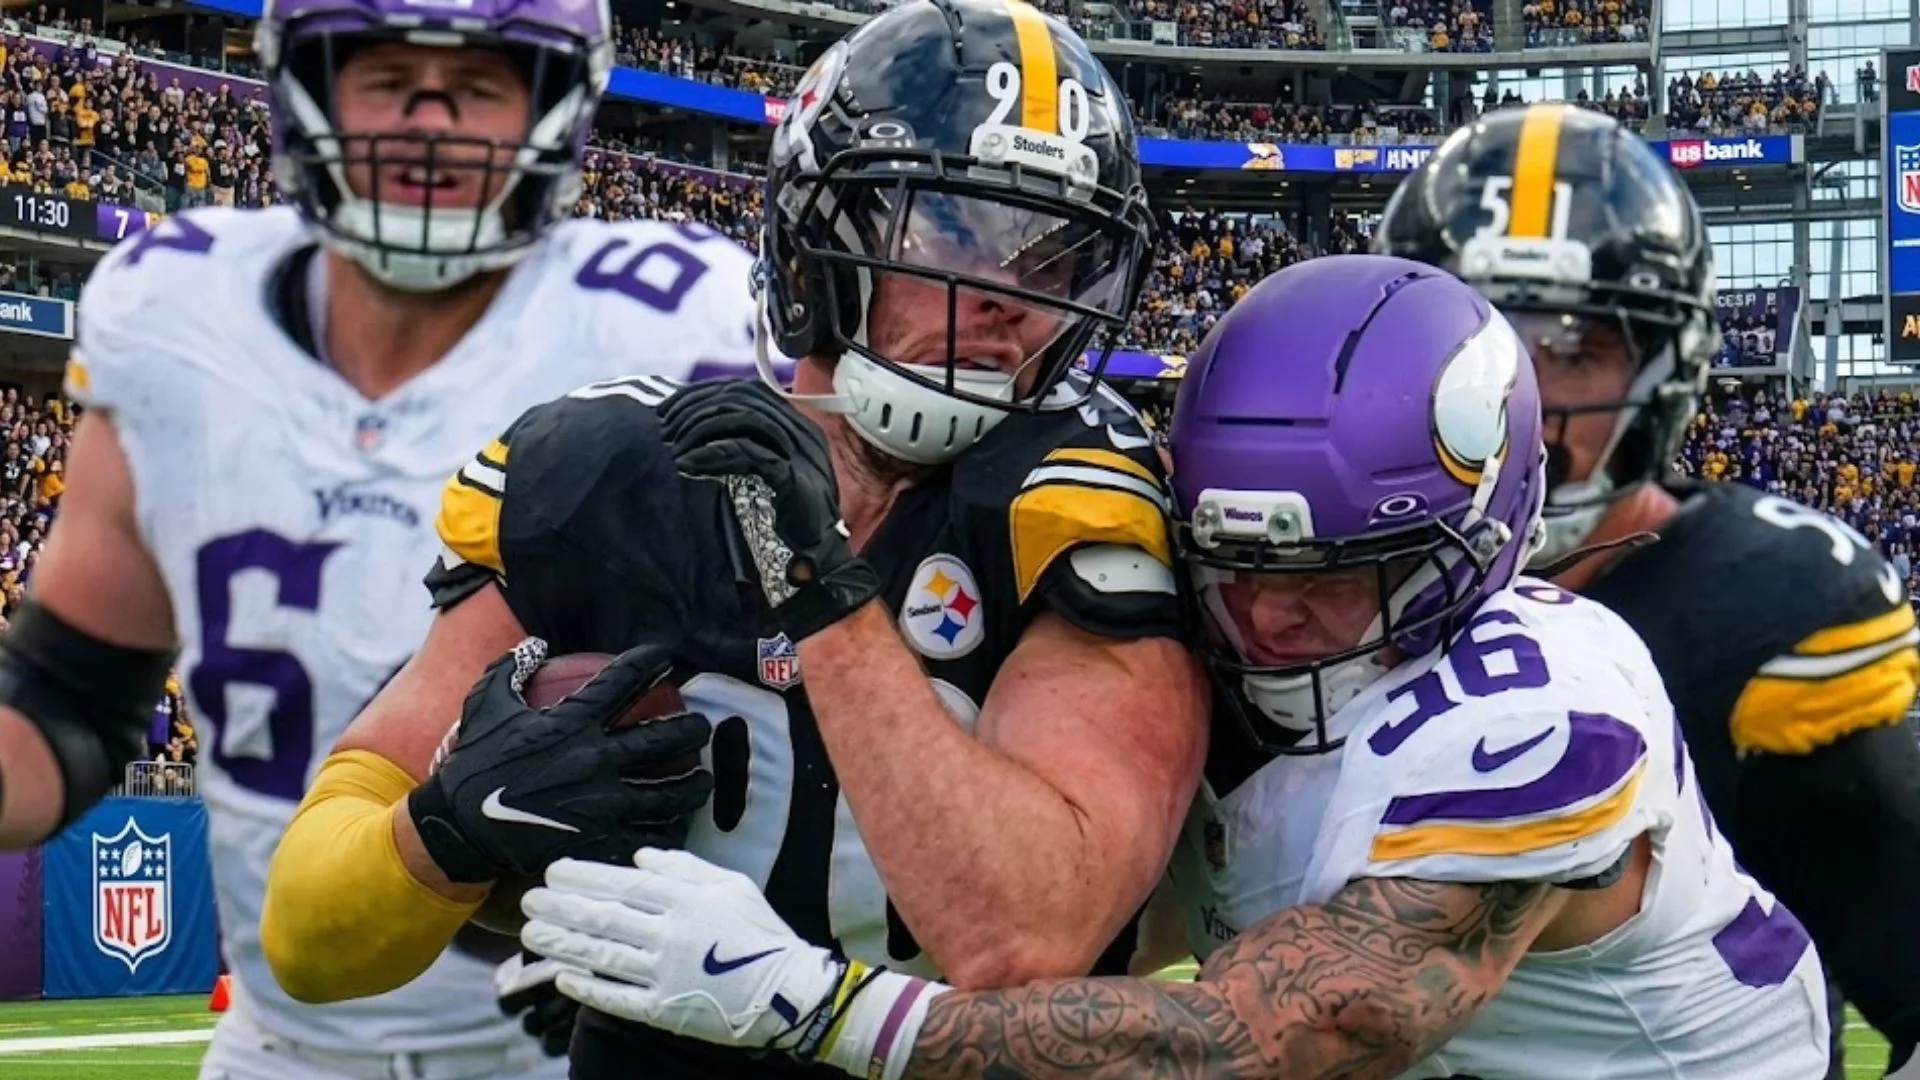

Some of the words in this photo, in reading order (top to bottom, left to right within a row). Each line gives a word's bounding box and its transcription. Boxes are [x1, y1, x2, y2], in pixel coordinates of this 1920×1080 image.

[1671, 144, 1702, 162] us
[1703, 139, 1764, 161] bank
[14, 194, 70, 228] 11:30
[114, 209, 130, 239] 7
[574, 222, 722, 313] 6
[0, 302, 33, 322] ank
[188, 525, 400, 806] 6
[103, 887, 162, 947] NFL
